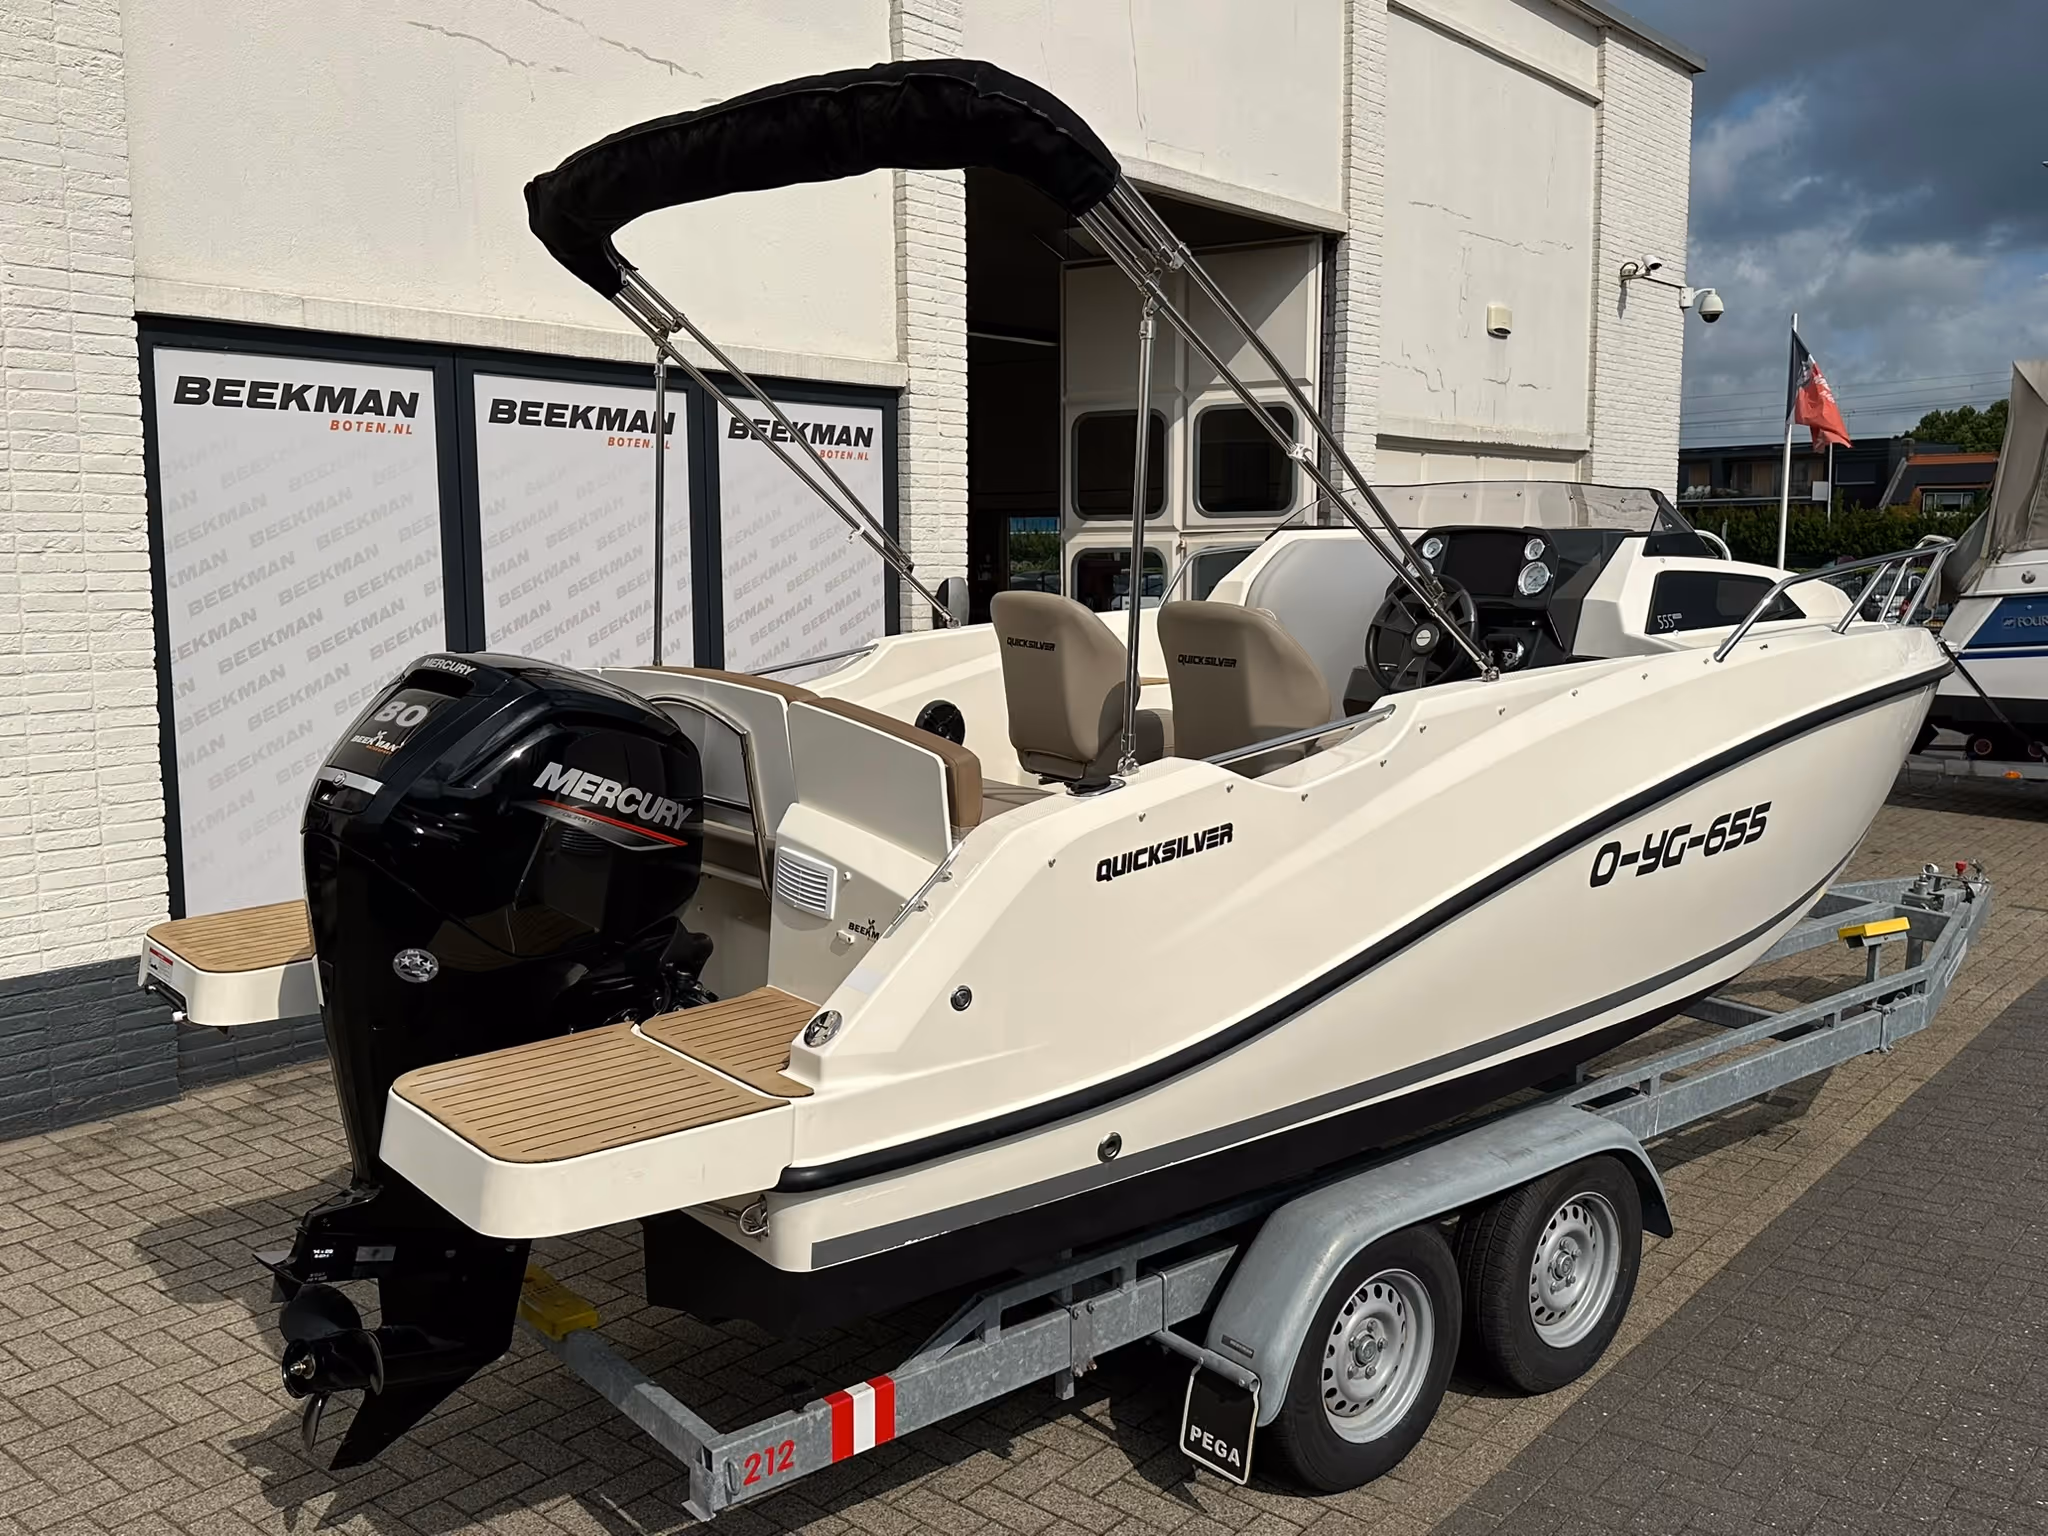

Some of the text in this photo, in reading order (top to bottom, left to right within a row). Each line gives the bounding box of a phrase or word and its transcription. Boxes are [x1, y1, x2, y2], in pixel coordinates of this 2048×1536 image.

[173, 375, 420, 419] BEEKMAN
[488, 398, 676, 436] BEEKMAN
[329, 419, 413, 435] BOTEN.NL
[607, 436, 671, 450] BOTEN.L
[727, 416, 874, 448] BEEKMAN
[819, 449, 870, 461] BOTEN.NL
[249, 486, 353, 550] BEEKMAN
[315, 491, 415, 550] BEEKMAN
[187, 551, 296, 617] BEEKMAN
[278, 544, 380, 607] BEEKMAN
[344, 545, 438, 607] BEEKMAN
[499, 551, 580, 608] BEEKMAN
[567, 545, 643, 600] BEEKMAN
[733, 552, 798, 602] BEEKMAN
[786, 545, 848, 594] BEEKMAN
[306, 597, 406, 662] BEEKMAN
[521, 600, 600, 656] BEEKMAN
[749, 594, 813, 647] BEEKMAN
[802, 587, 862, 637] BEEKMAN
[1657, 613, 1675, 630] 555
[217, 608, 324, 675] BEEKMAN
[1007, 636, 1056, 652] QUICKSILVER
[1178, 653, 1237, 669] QUICKSILVER
[421, 658, 477, 677] MERCURY
[178, 663, 287, 735] BEEKMAN
[247, 663, 351, 732] BEEKMAN
[374, 700, 429, 727] 80
[207, 719, 313, 791] BEEKMAN
[533, 761, 693, 831] MERCURY
[1096, 822, 1234, 882] QUICKSILVER
[743, 1440, 795, 1486] 212
[1189, 1424, 1240, 1468] PEGA
